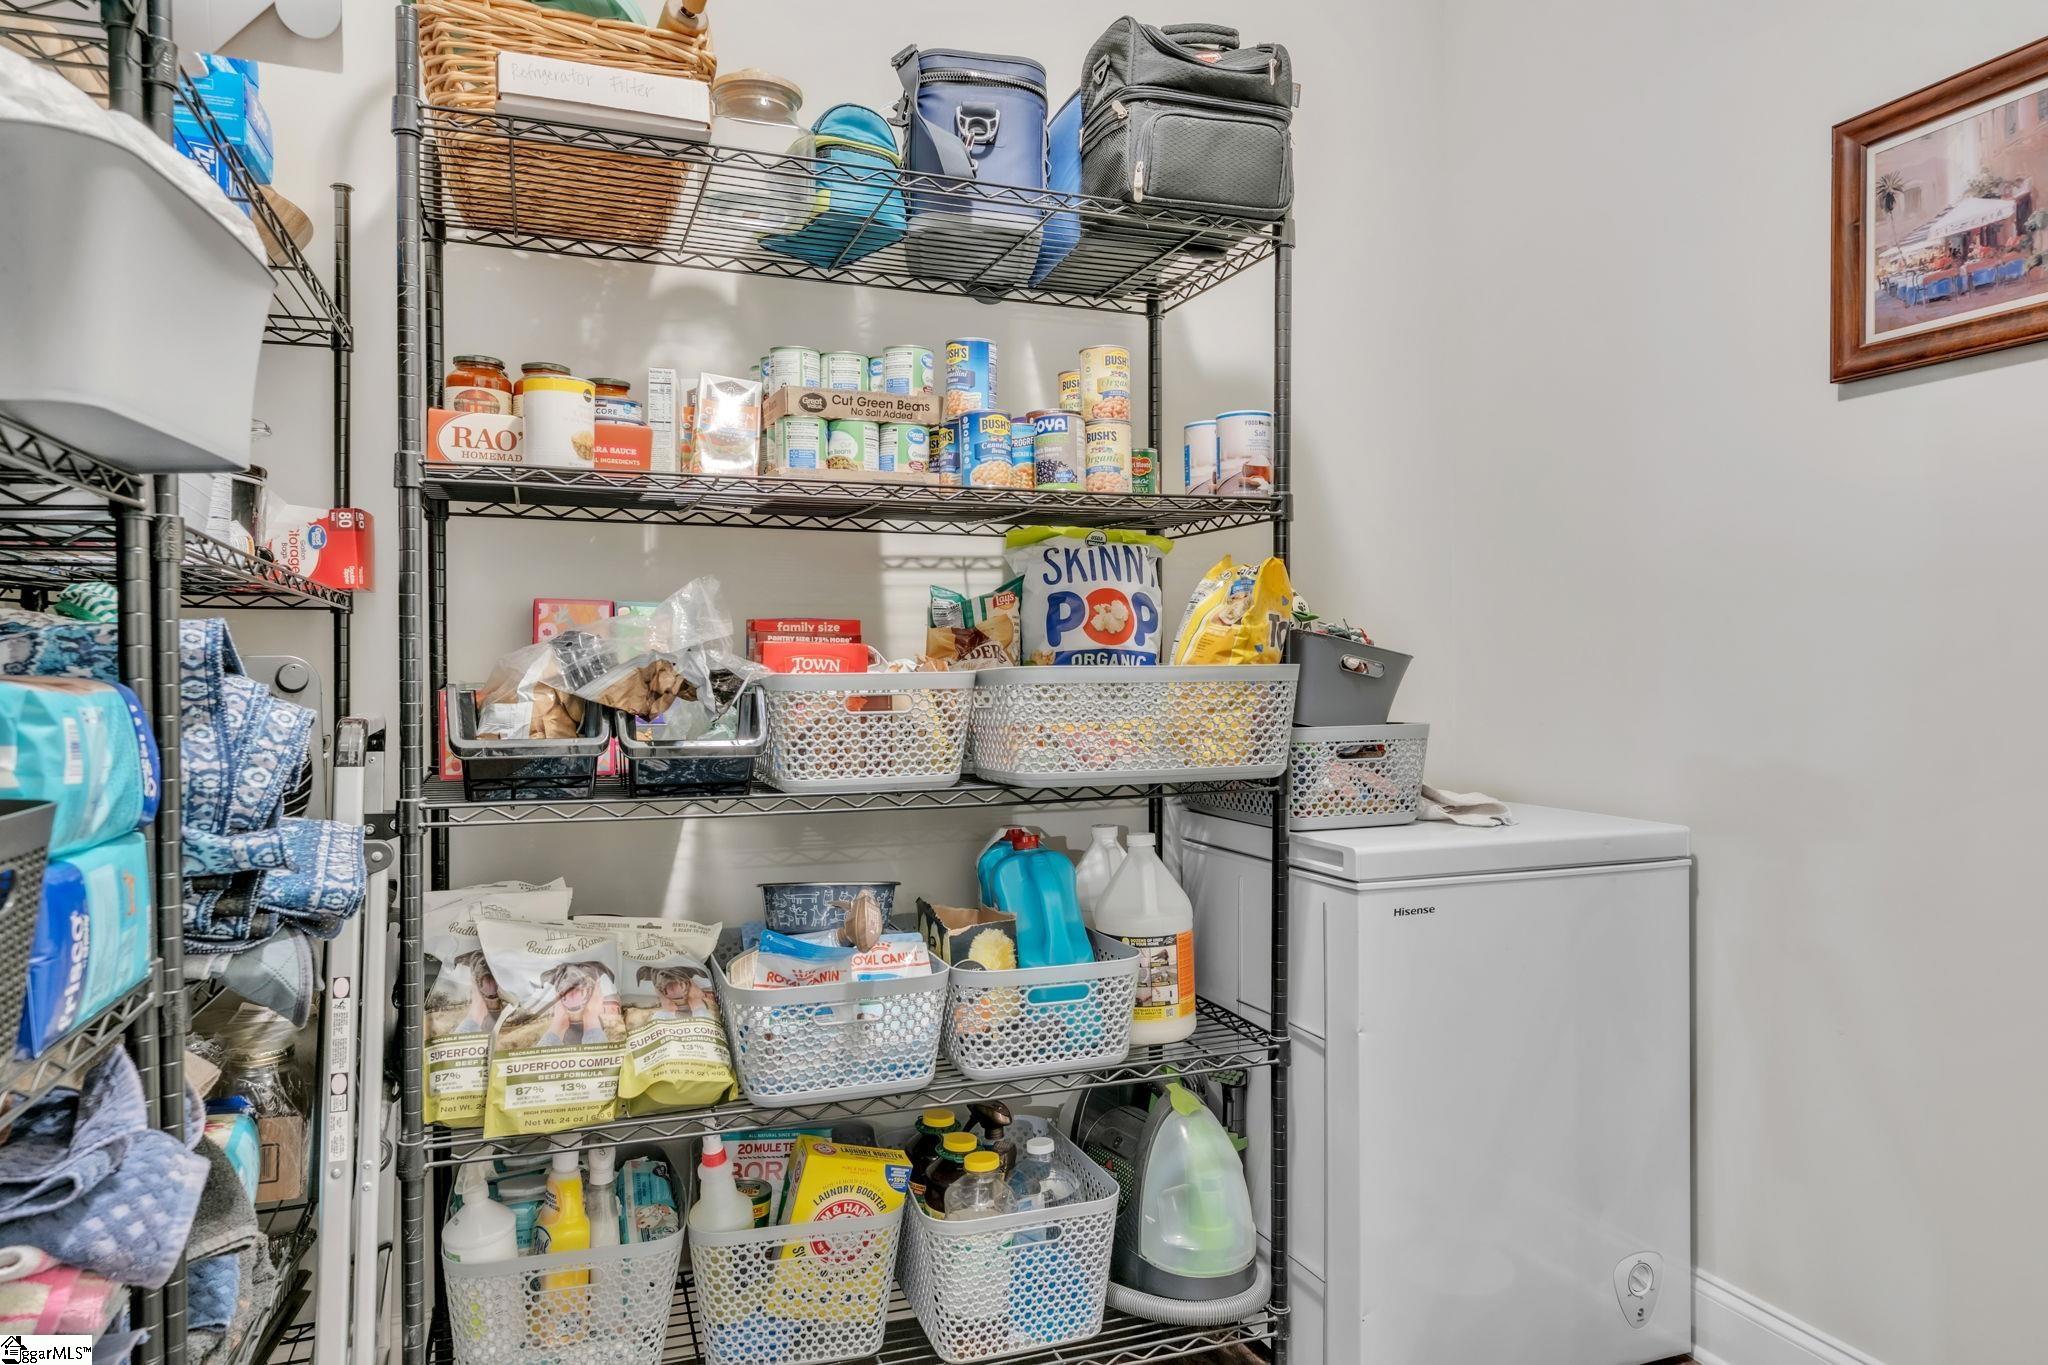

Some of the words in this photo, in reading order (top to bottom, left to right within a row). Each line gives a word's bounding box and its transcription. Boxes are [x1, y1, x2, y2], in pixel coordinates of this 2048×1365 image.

[511, 63, 592, 88] Refrigerator
[610, 75, 653, 97] Filter
[802, 398, 822, 406] Great
[832, 394, 853, 407] Cut
[857, 397, 893, 410] Green
[897, 399, 931, 412] Beans
[851, 408, 863, 416] No
[865, 408, 881, 418] Salt
[882, 410, 913, 420] Added
[981, 419, 1011, 433] BUSH'S
[1033, 418, 1066, 433] OYA
[1086, 430, 1117, 444] BUSH'S
[1254, 429, 1266, 437] Salt
[462, 450, 523, 462] HOMEMAD
[610, 447, 637, 456] SAUCE
[600, 457, 640, 466] INGREDIENTS
[338, 512, 352, 528] 80
[995, 592, 1015, 607] Lay's
[777, 621, 815, 633] family
[817, 621, 841, 632] size
[791, 656, 841, 673] TOWN
[1071, 650, 1147, 666] ORGANIC
[1393, 906, 1435, 917] Hisense
[526, 940, 576, 957] Badlands
[881, 948, 917, 966] CAN
[630, 1027, 691, 1050] SUPERFOOD
[541, 1046, 577, 1054] INGREDIENTS
[506, 1059, 576, 1074] SUPERFOOD
[435, 1072, 461, 1083] 87%
[538, 1073, 561, 1081] BEEF
[564, 1070, 604, 1079] FORMULA
[515, 1086, 545, 1096] 87%
[561, 1082, 587, 1092] 13%
[568, 1105, 586, 1113] ADULT
[524, 1119, 541, 1127] Net
[559, 1116, 571, 1124] 24
[738, 1144, 753, 1155] 20
[754, 1142, 782, 1153] MULE
[840, 1147, 871, 1155] LAUNDRY
[872, 1150, 904, 1160] BOOSTER
[813, 1185, 854, 1206] LAUNDRY
[856, 1186, 887, 1211] BOOSTER
[832, 1206, 842, 1215] &
